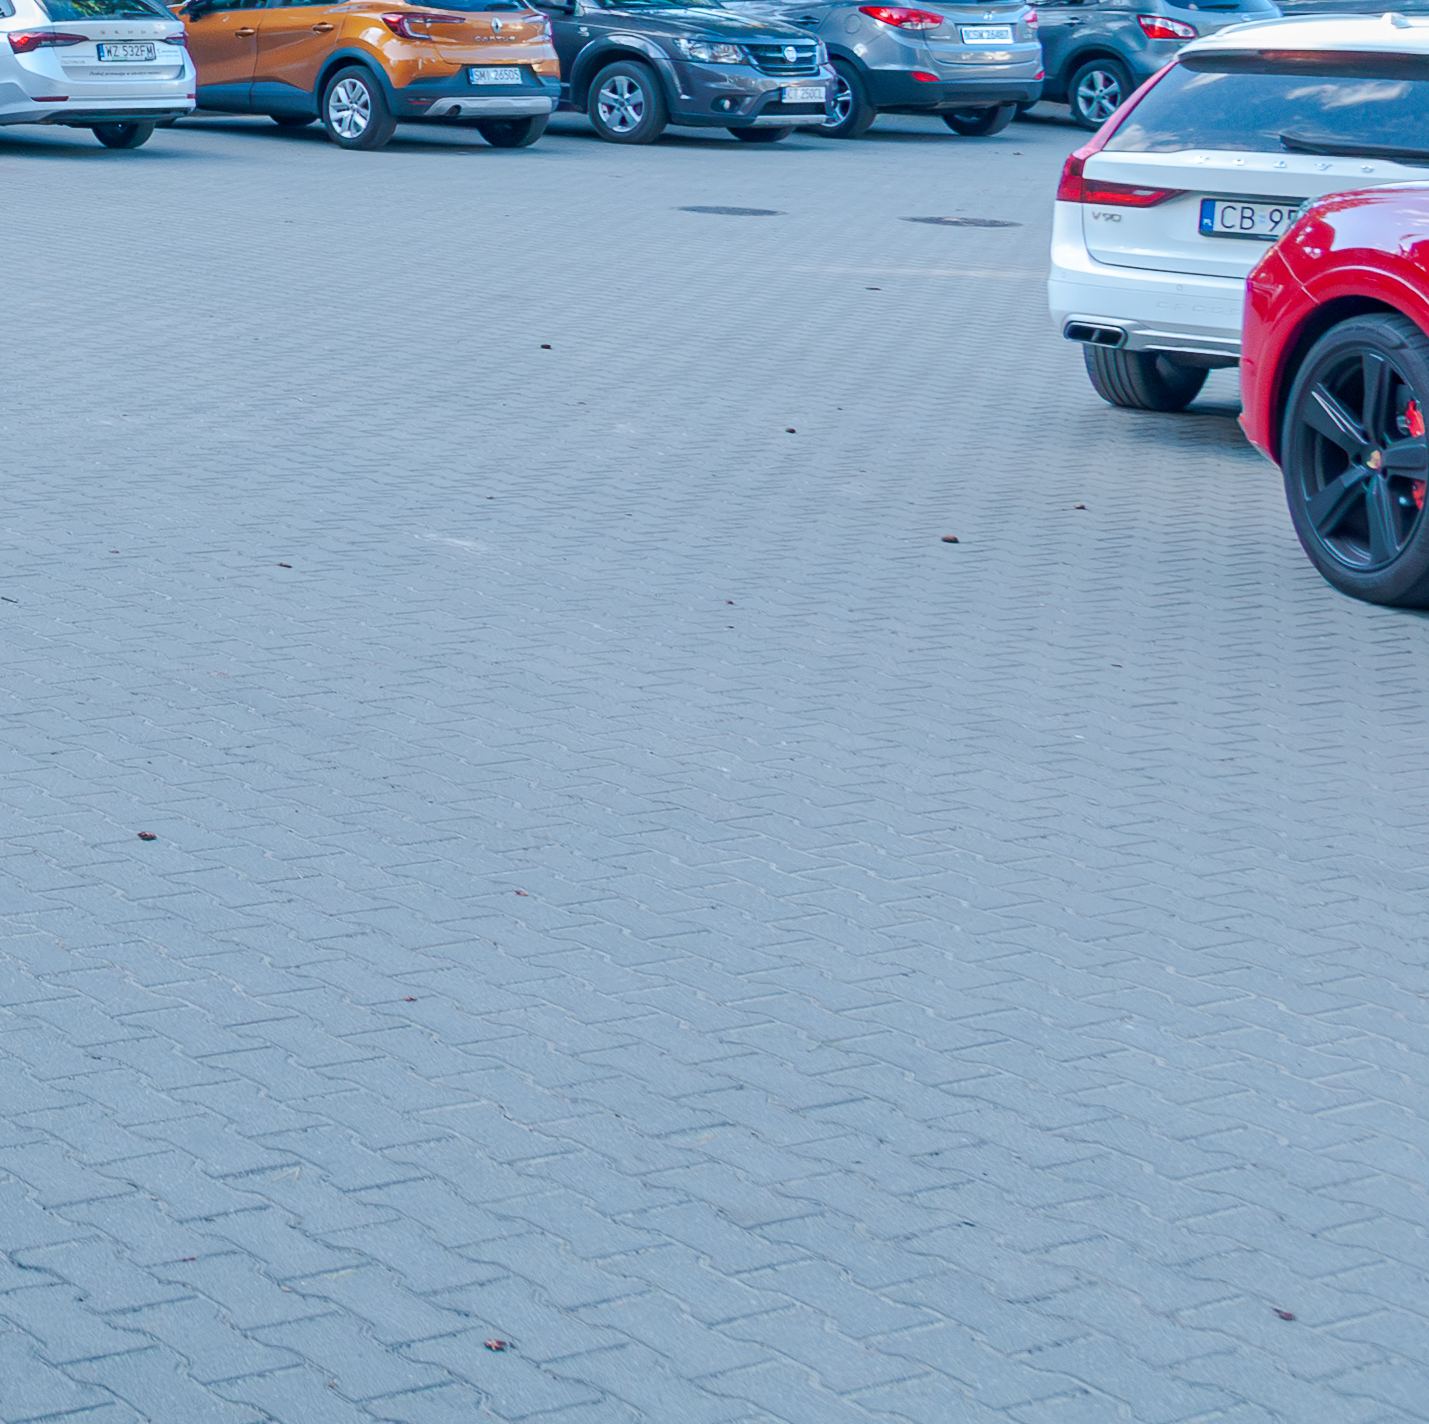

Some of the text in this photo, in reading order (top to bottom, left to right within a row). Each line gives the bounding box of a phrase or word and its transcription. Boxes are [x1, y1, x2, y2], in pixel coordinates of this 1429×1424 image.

[104, 44, 121, 58] WZ
[1092, 210, 1122, 223] V90
[1220, 206, 1256, 231] CB
